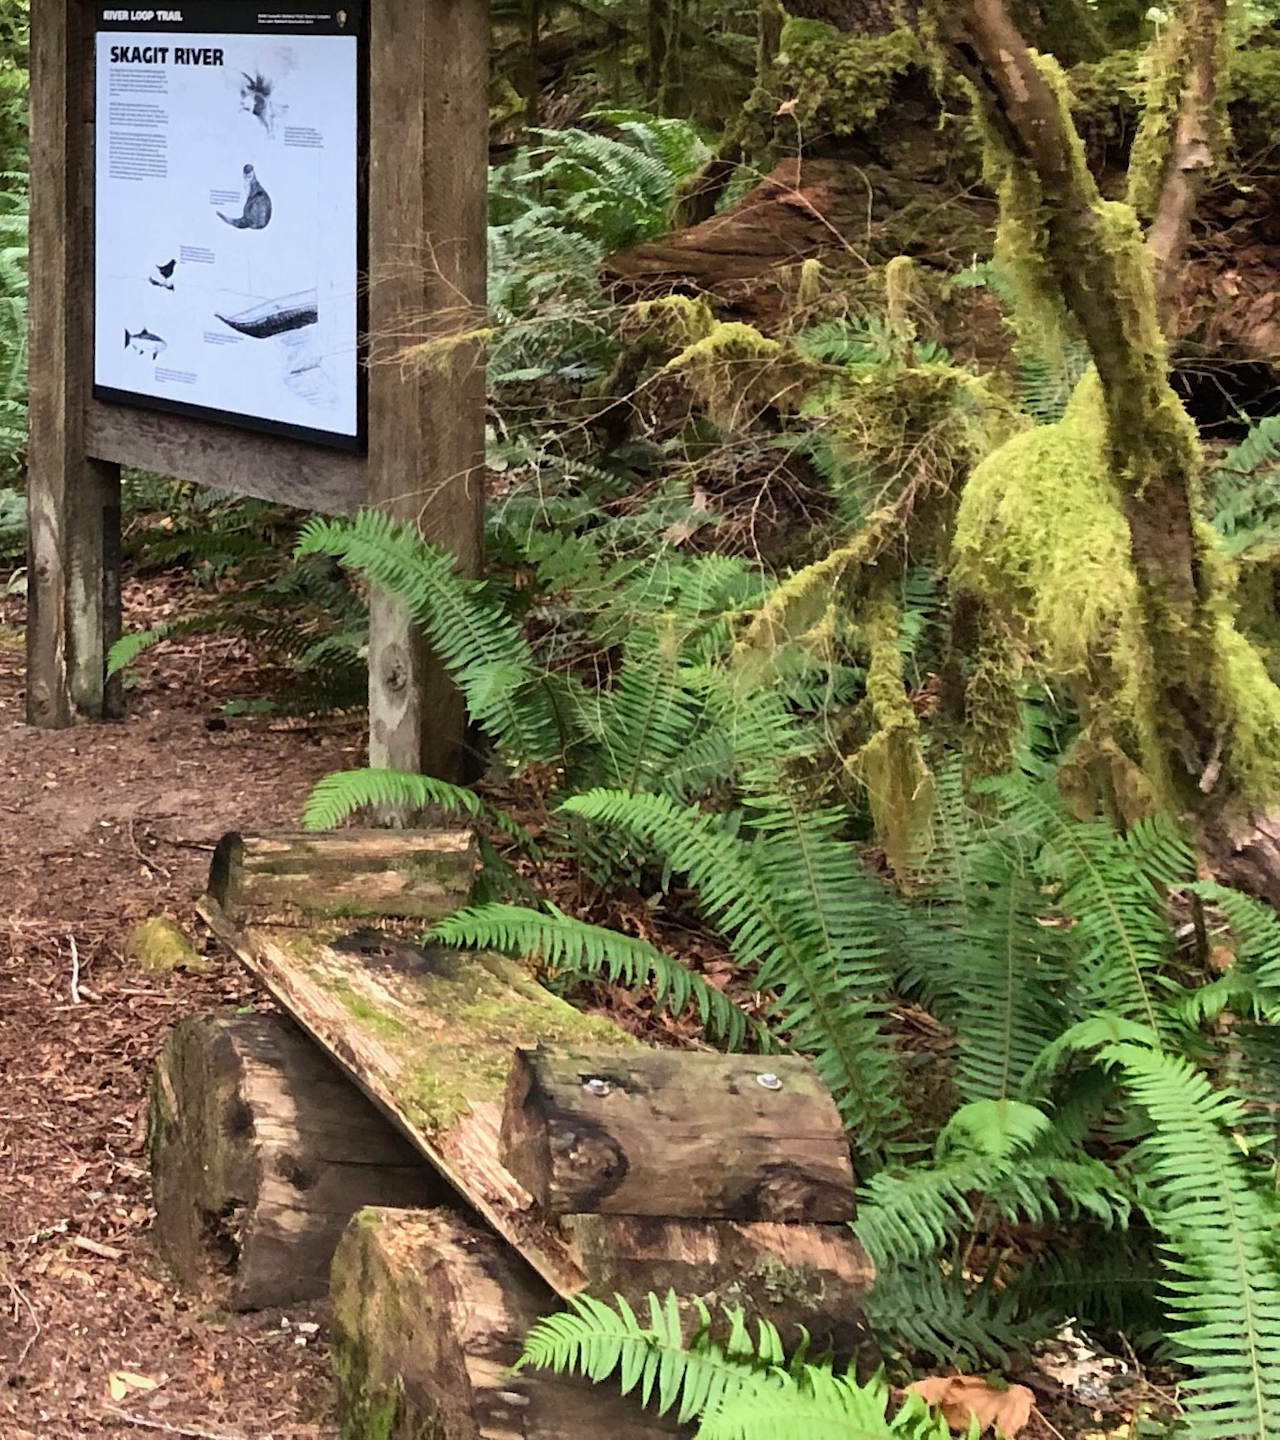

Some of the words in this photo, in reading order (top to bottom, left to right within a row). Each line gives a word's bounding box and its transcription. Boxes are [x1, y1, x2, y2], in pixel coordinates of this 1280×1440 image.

[103, 10, 129, 21] RIVER
[130, 10, 155, 21] LOOP
[156, 10, 183, 22] TRAIL
[110, 46, 169, 64] SKAGIT
[174, 47, 224, 66] RIVER
